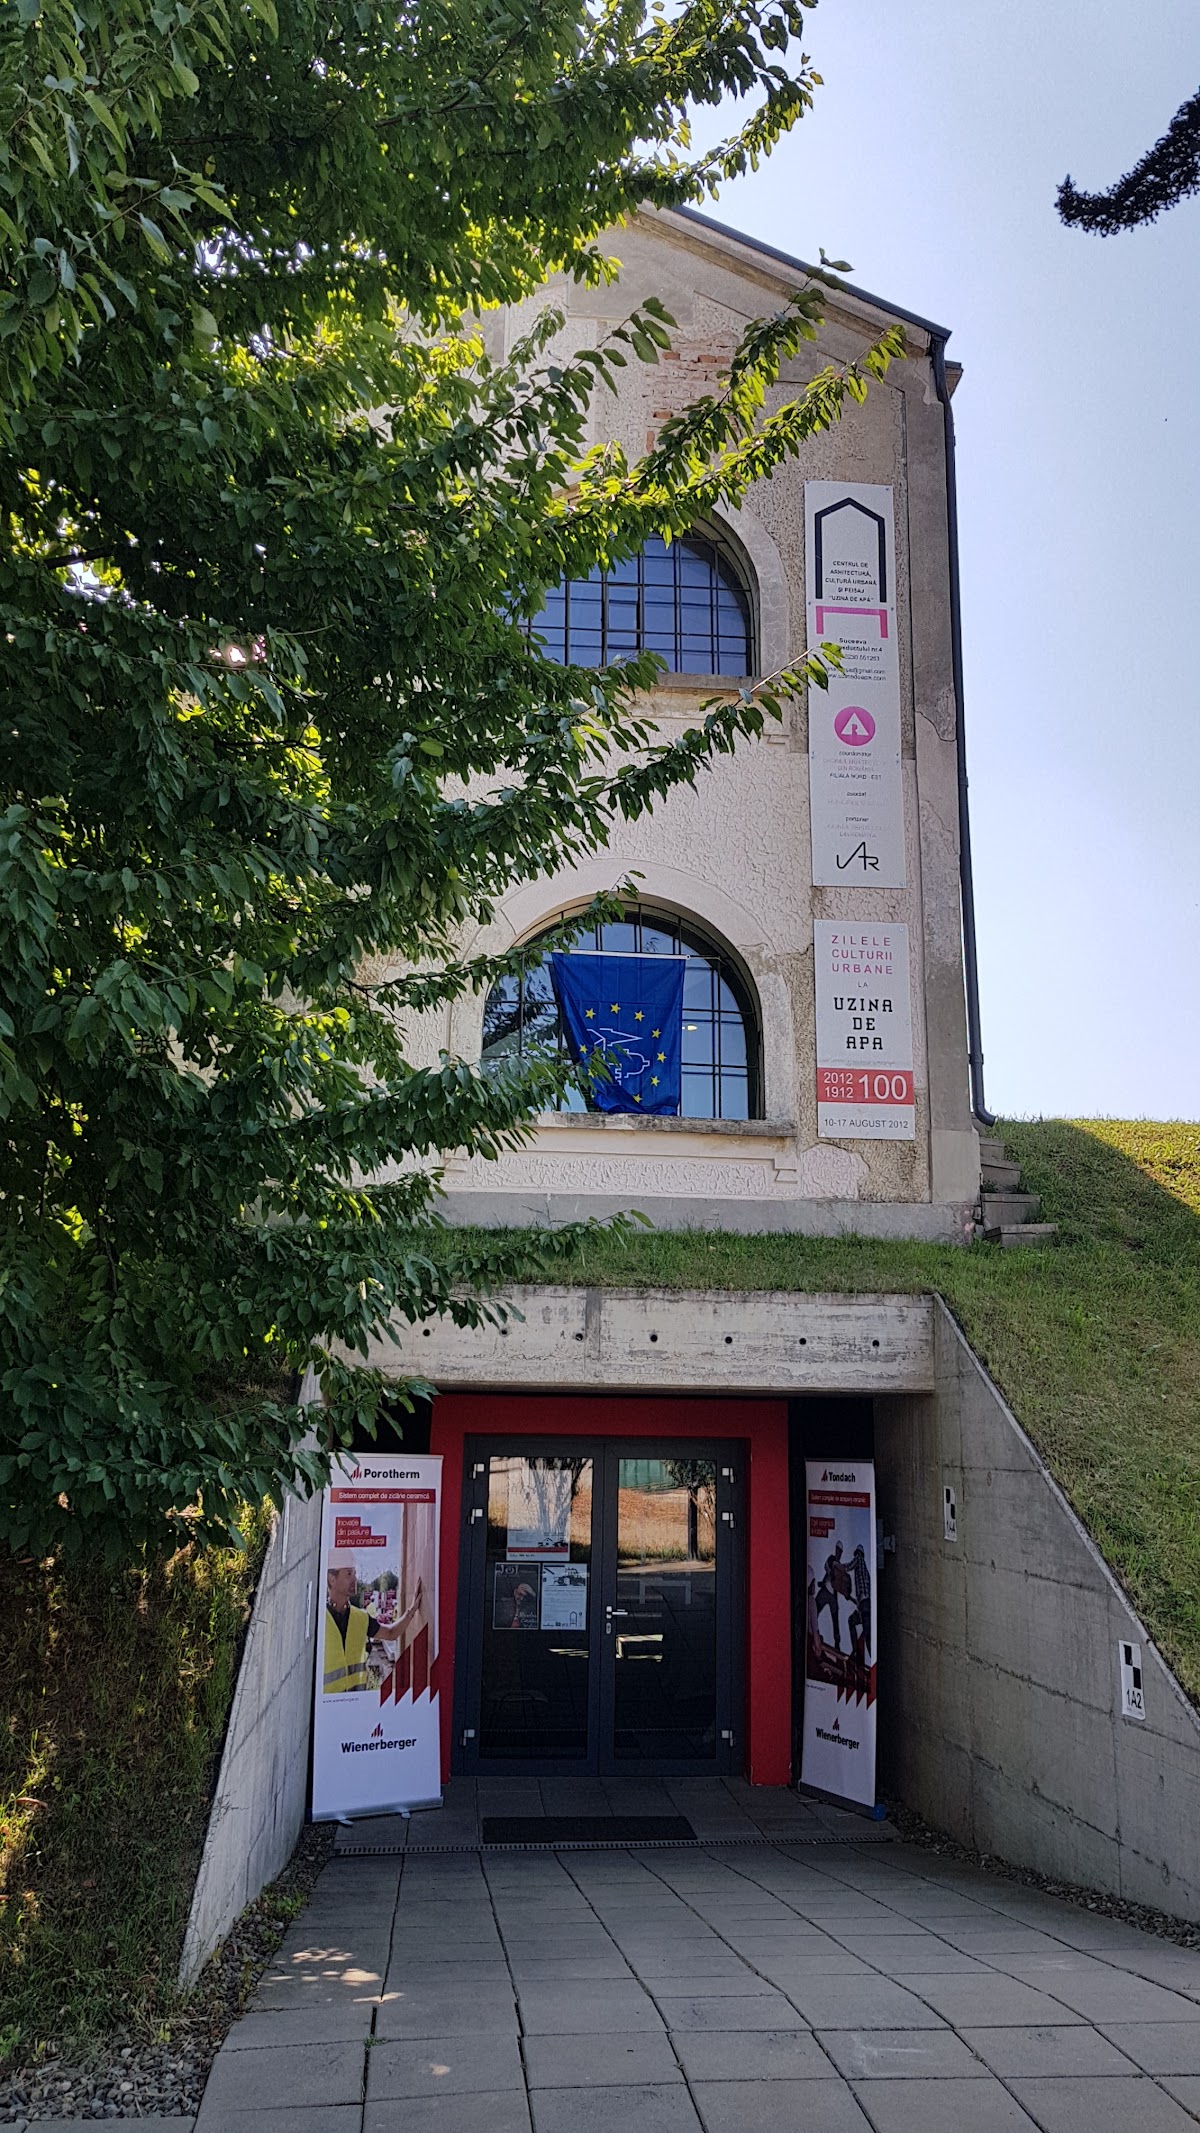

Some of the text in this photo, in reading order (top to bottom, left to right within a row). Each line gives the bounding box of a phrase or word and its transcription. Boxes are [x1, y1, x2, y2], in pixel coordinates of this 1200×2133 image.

[839, 637, 867, 645] Suceava
[831, 935, 891, 947] ZILELE
[831, 949, 893, 961] CULTURII
[831, 963, 893, 974] URBANE
[834, 997, 893, 1013] UZINA
[852, 1017, 876, 1031] DE
[846, 1036, 883, 1050] APA
[823, 1072, 853, 1085] 2012
[825, 1086, 854, 1099] 1912
[858, 1074, 907, 1100] 100
[824, 1118, 909, 1129] 10-17 AUGUST 2012
[364, 1468, 420, 1479] Porotherm
[828, 1471, 856, 1483] Tondach
[358, 1492, 380, 1500] complet
[336, 1528, 370, 1537] din pasiune
[336, 1538, 355, 1547] pentru
[1126, 1689, 1142, 1709] 1A2
[816, 1727, 860, 1750] Wienerberger
[341, 1738, 417, 1753] Wienerberger
